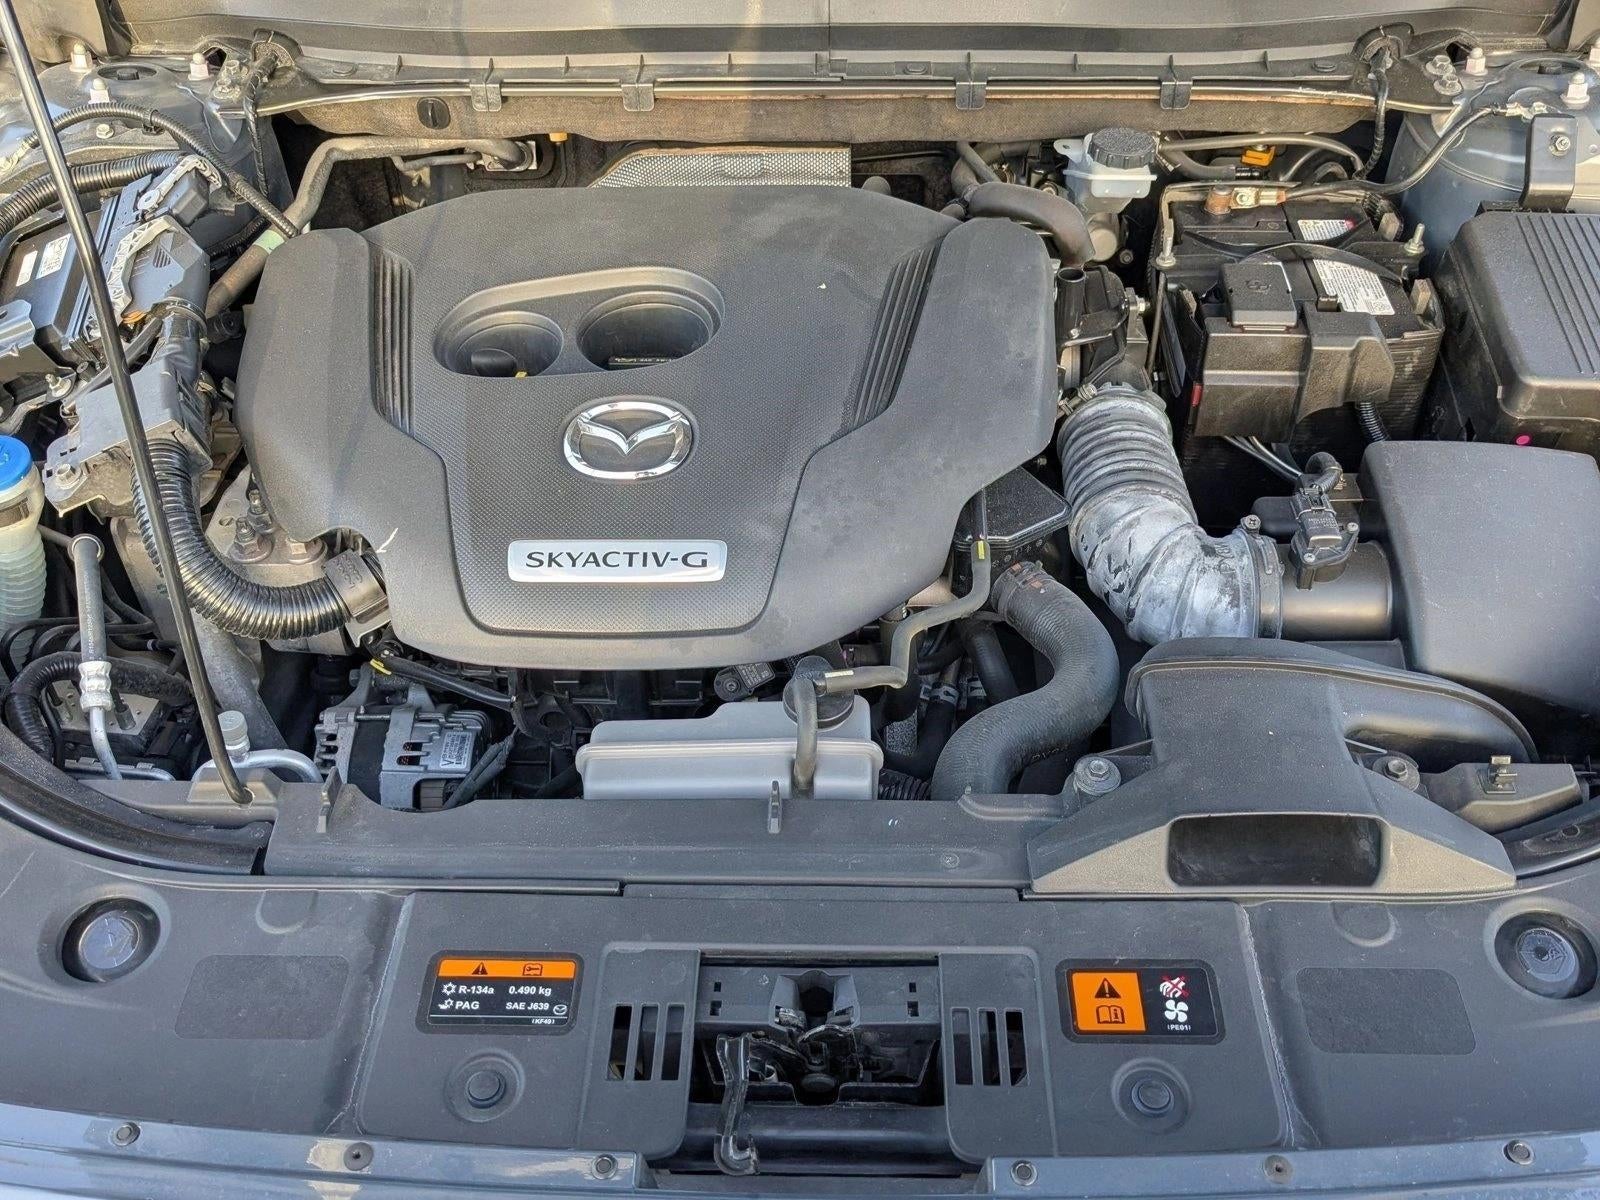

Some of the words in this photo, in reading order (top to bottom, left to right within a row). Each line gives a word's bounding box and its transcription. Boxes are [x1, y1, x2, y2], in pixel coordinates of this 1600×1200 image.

[525, 551, 708, 568] SKYACTIV-G
[458, 985, 495, 995] R-134a
[508, 985, 536, 995] 0.490
[538, 985, 552, 997] kg
[455, 1001, 481, 1010] PAG
[505, 1002, 526, 1010] SAE
[527, 1002, 550, 1011] J639
